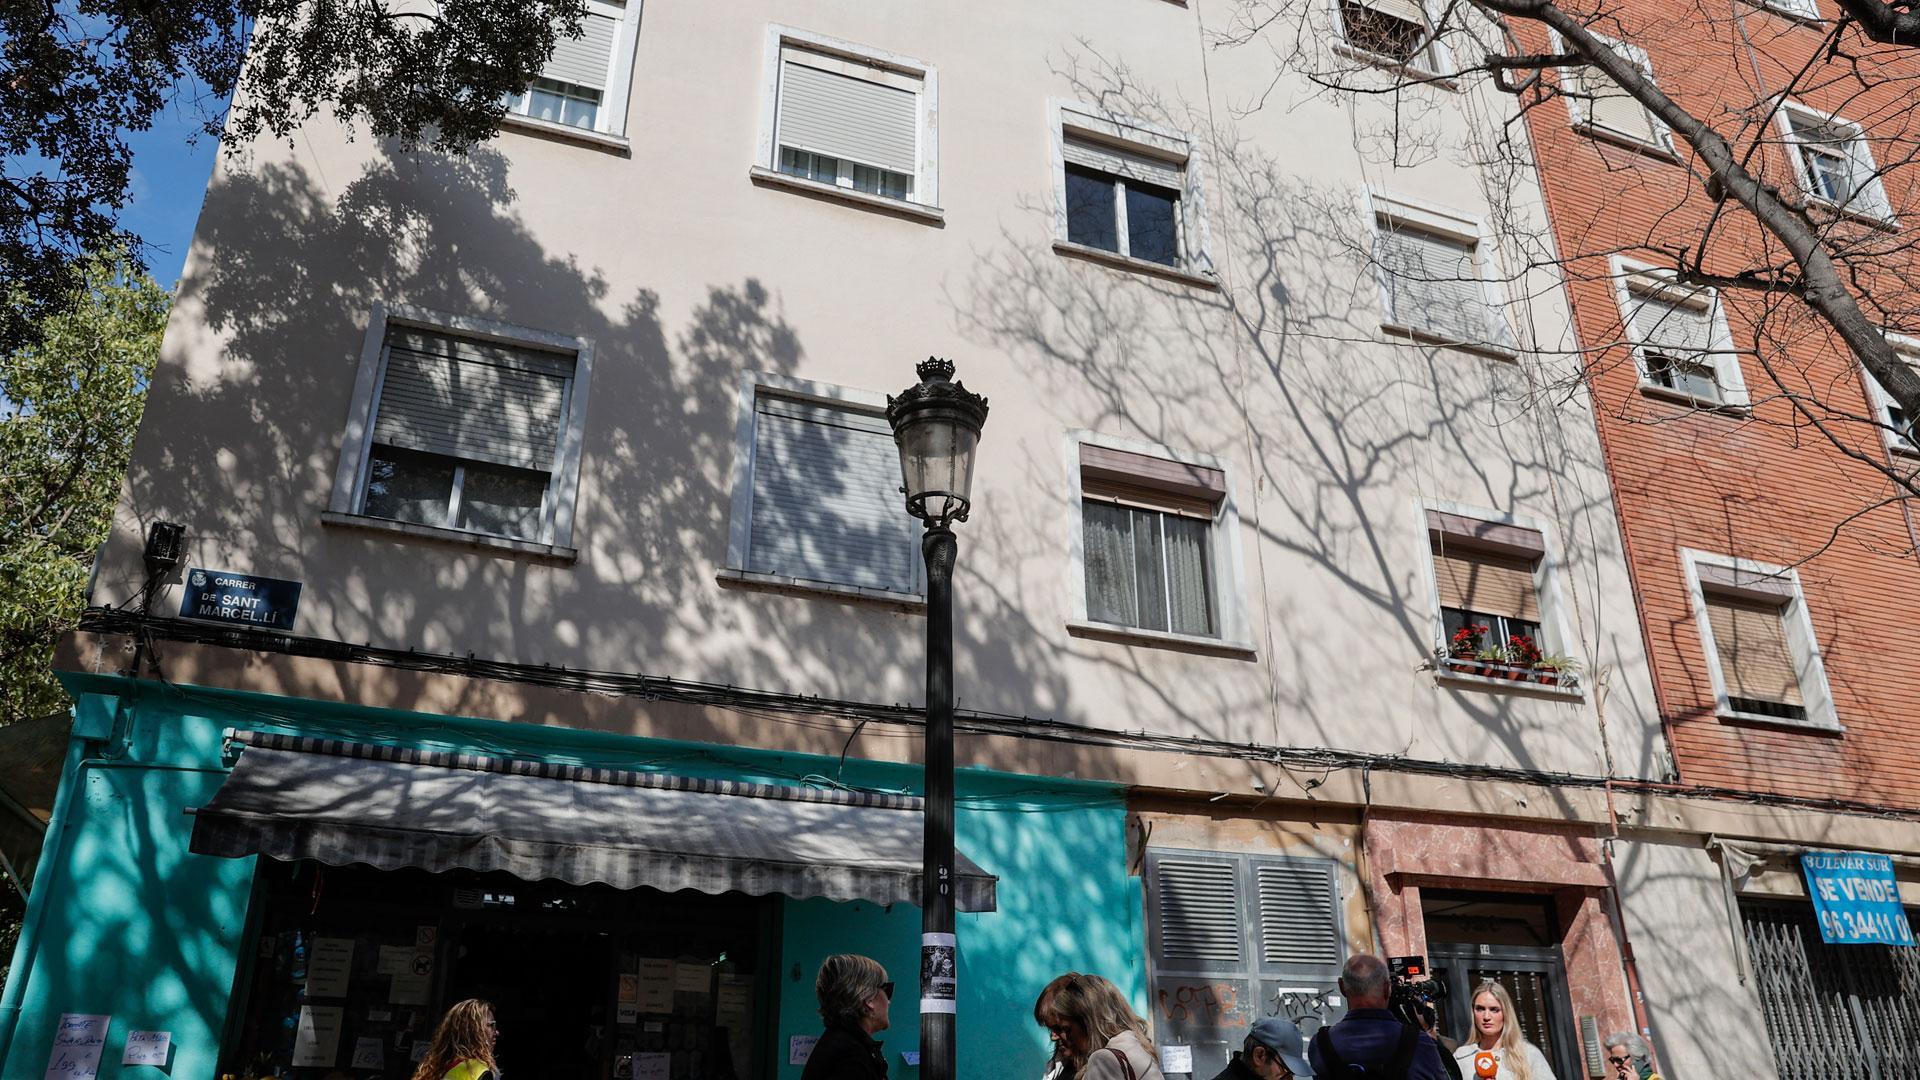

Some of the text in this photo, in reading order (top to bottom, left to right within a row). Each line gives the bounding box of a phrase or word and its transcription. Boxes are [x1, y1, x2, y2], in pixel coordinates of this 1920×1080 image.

[215, 577, 256, 590] CARRER
[202, 593, 261, 608] DE SANT
[1805, 855, 1890, 872] BULEVAR SUR
[1816, 877, 1898, 903] SE VENDE
[1821, 910, 1845, 938] 96
[619, 1008, 636, 1017] VISA
